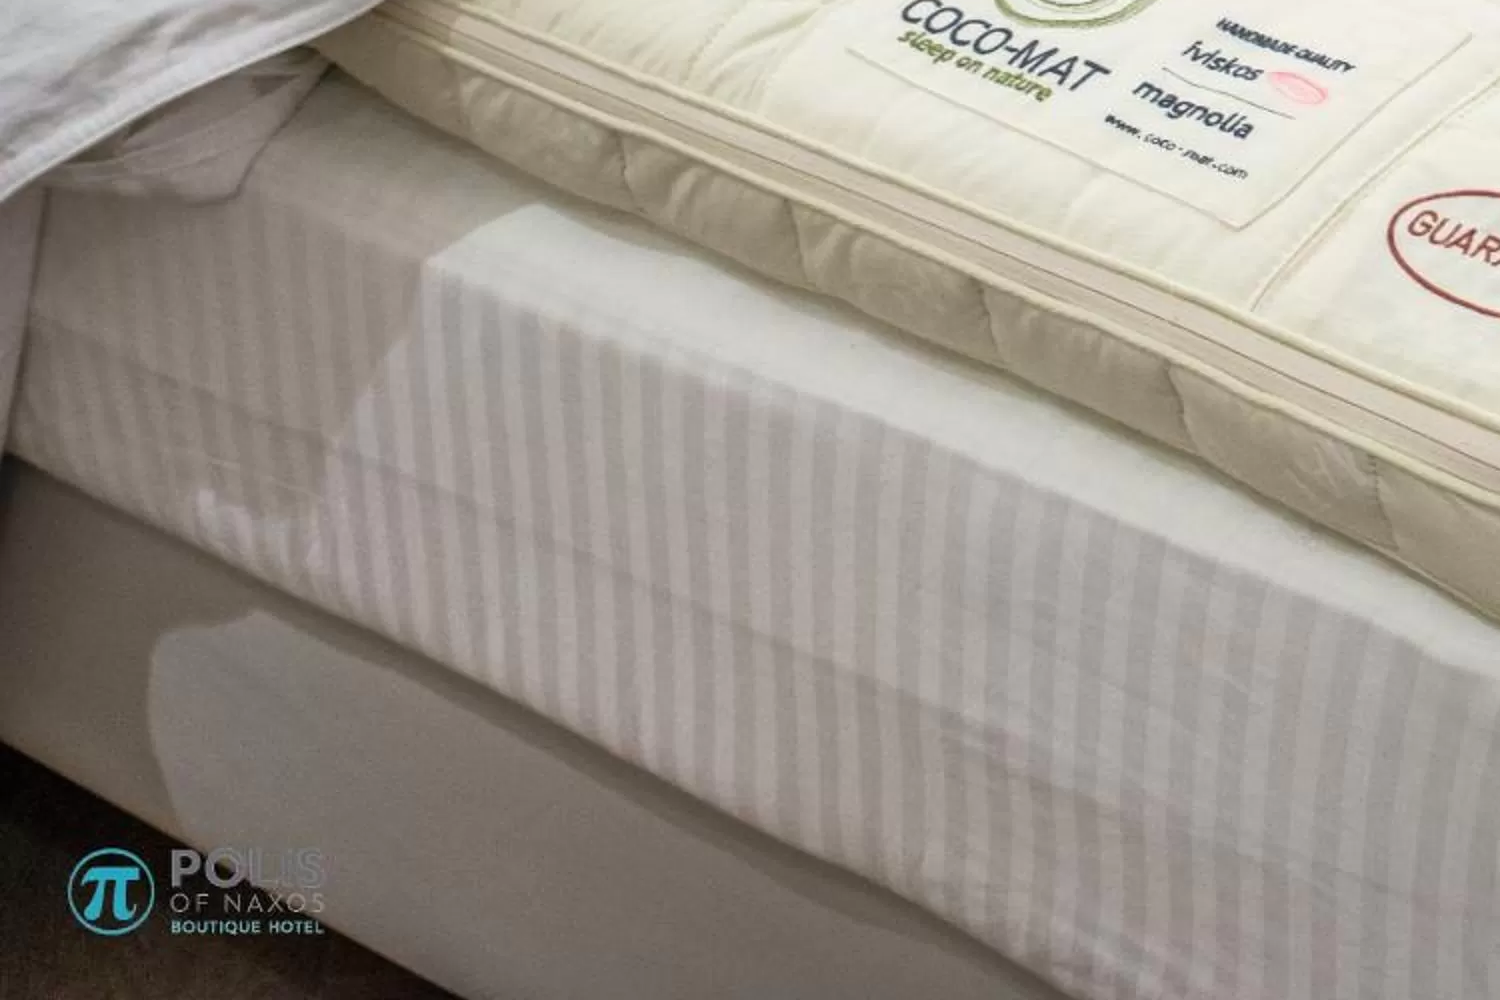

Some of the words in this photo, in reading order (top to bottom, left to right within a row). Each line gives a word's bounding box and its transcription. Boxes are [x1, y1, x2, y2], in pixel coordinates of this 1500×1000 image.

[897, 30, 957, 64] sleep
[955, 54, 984, 73] on
[982, 65, 1053, 102] nature
[1132, 81, 1254, 140] magnolia
